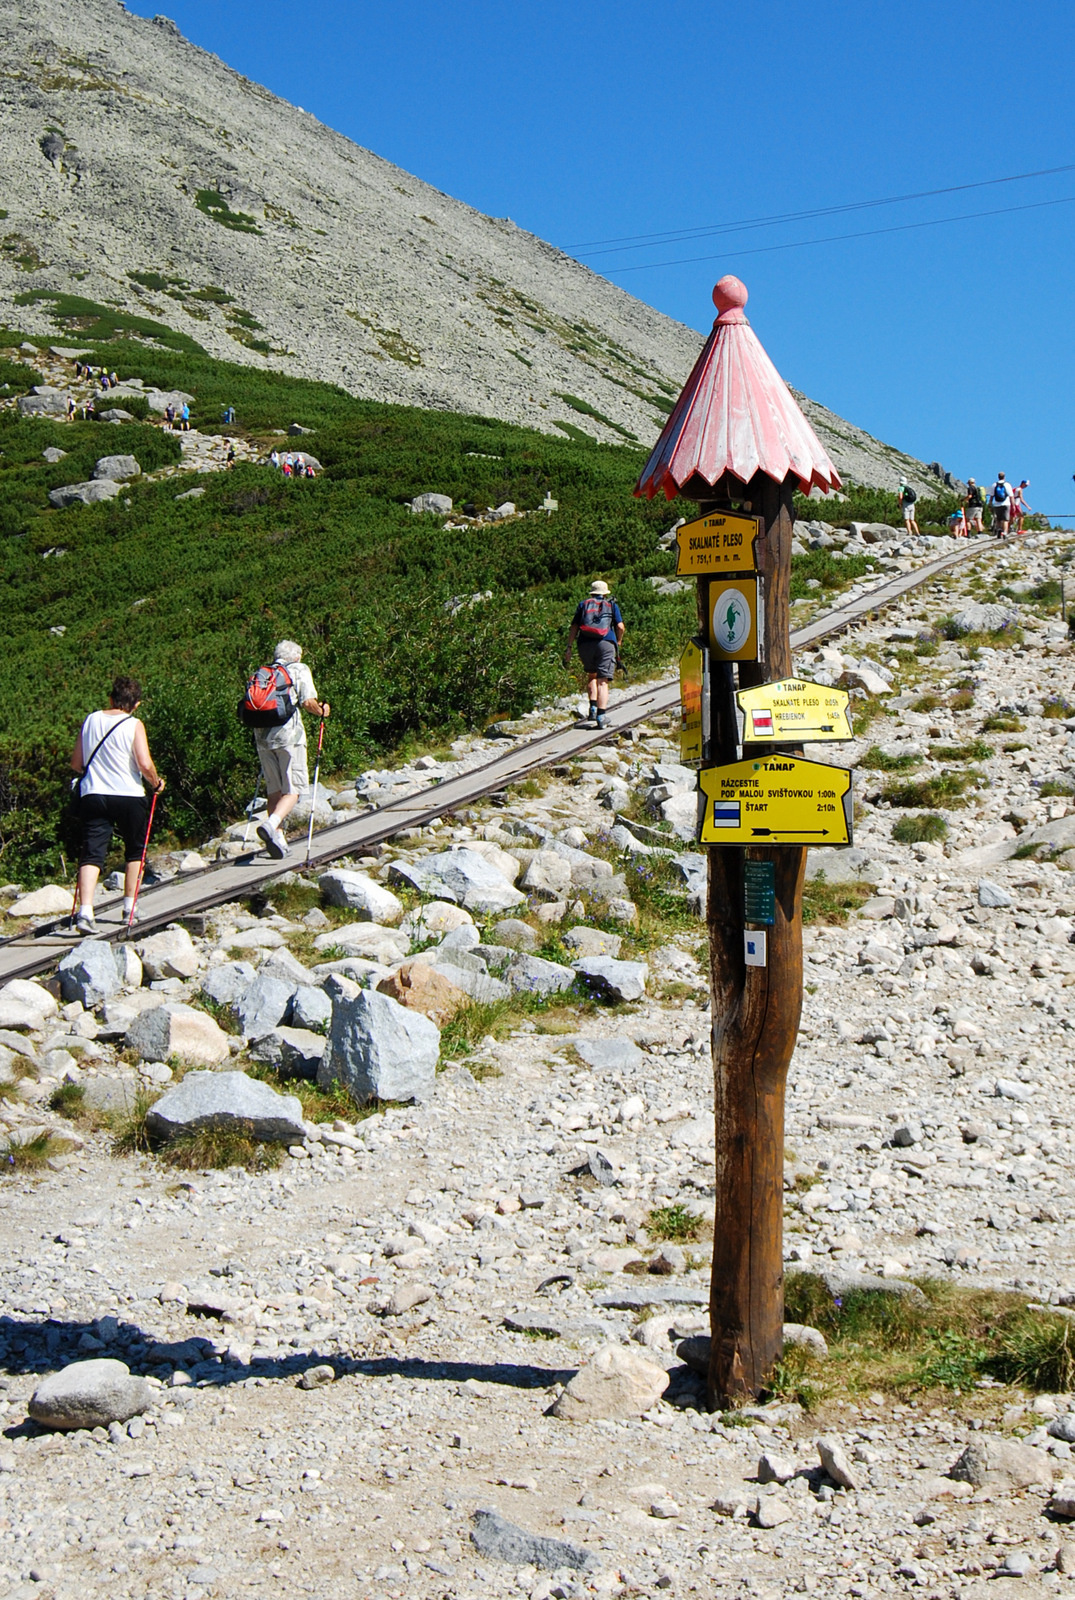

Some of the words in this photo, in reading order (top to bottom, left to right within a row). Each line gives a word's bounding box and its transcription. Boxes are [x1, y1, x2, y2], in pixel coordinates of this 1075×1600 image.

[689, 532, 720, 550] SKALNATÉ
[723, 533, 743, 547] PLESO
[690, 556, 694, 565] 1
[697, 554, 712, 565] 751,1
[715, 555, 721, 563] m
[763, 763, 795, 771] TANAP
[721, 778, 759, 788] RÁZCESTIE
[721, 790, 735, 798] POD
[739, 790, 764, 798] MALOU
[768, 788, 813, 798] SVIŠŤOVKOU
[817, 790, 836, 798] 1:00h
[746, 802, 768, 812] ŠTART
